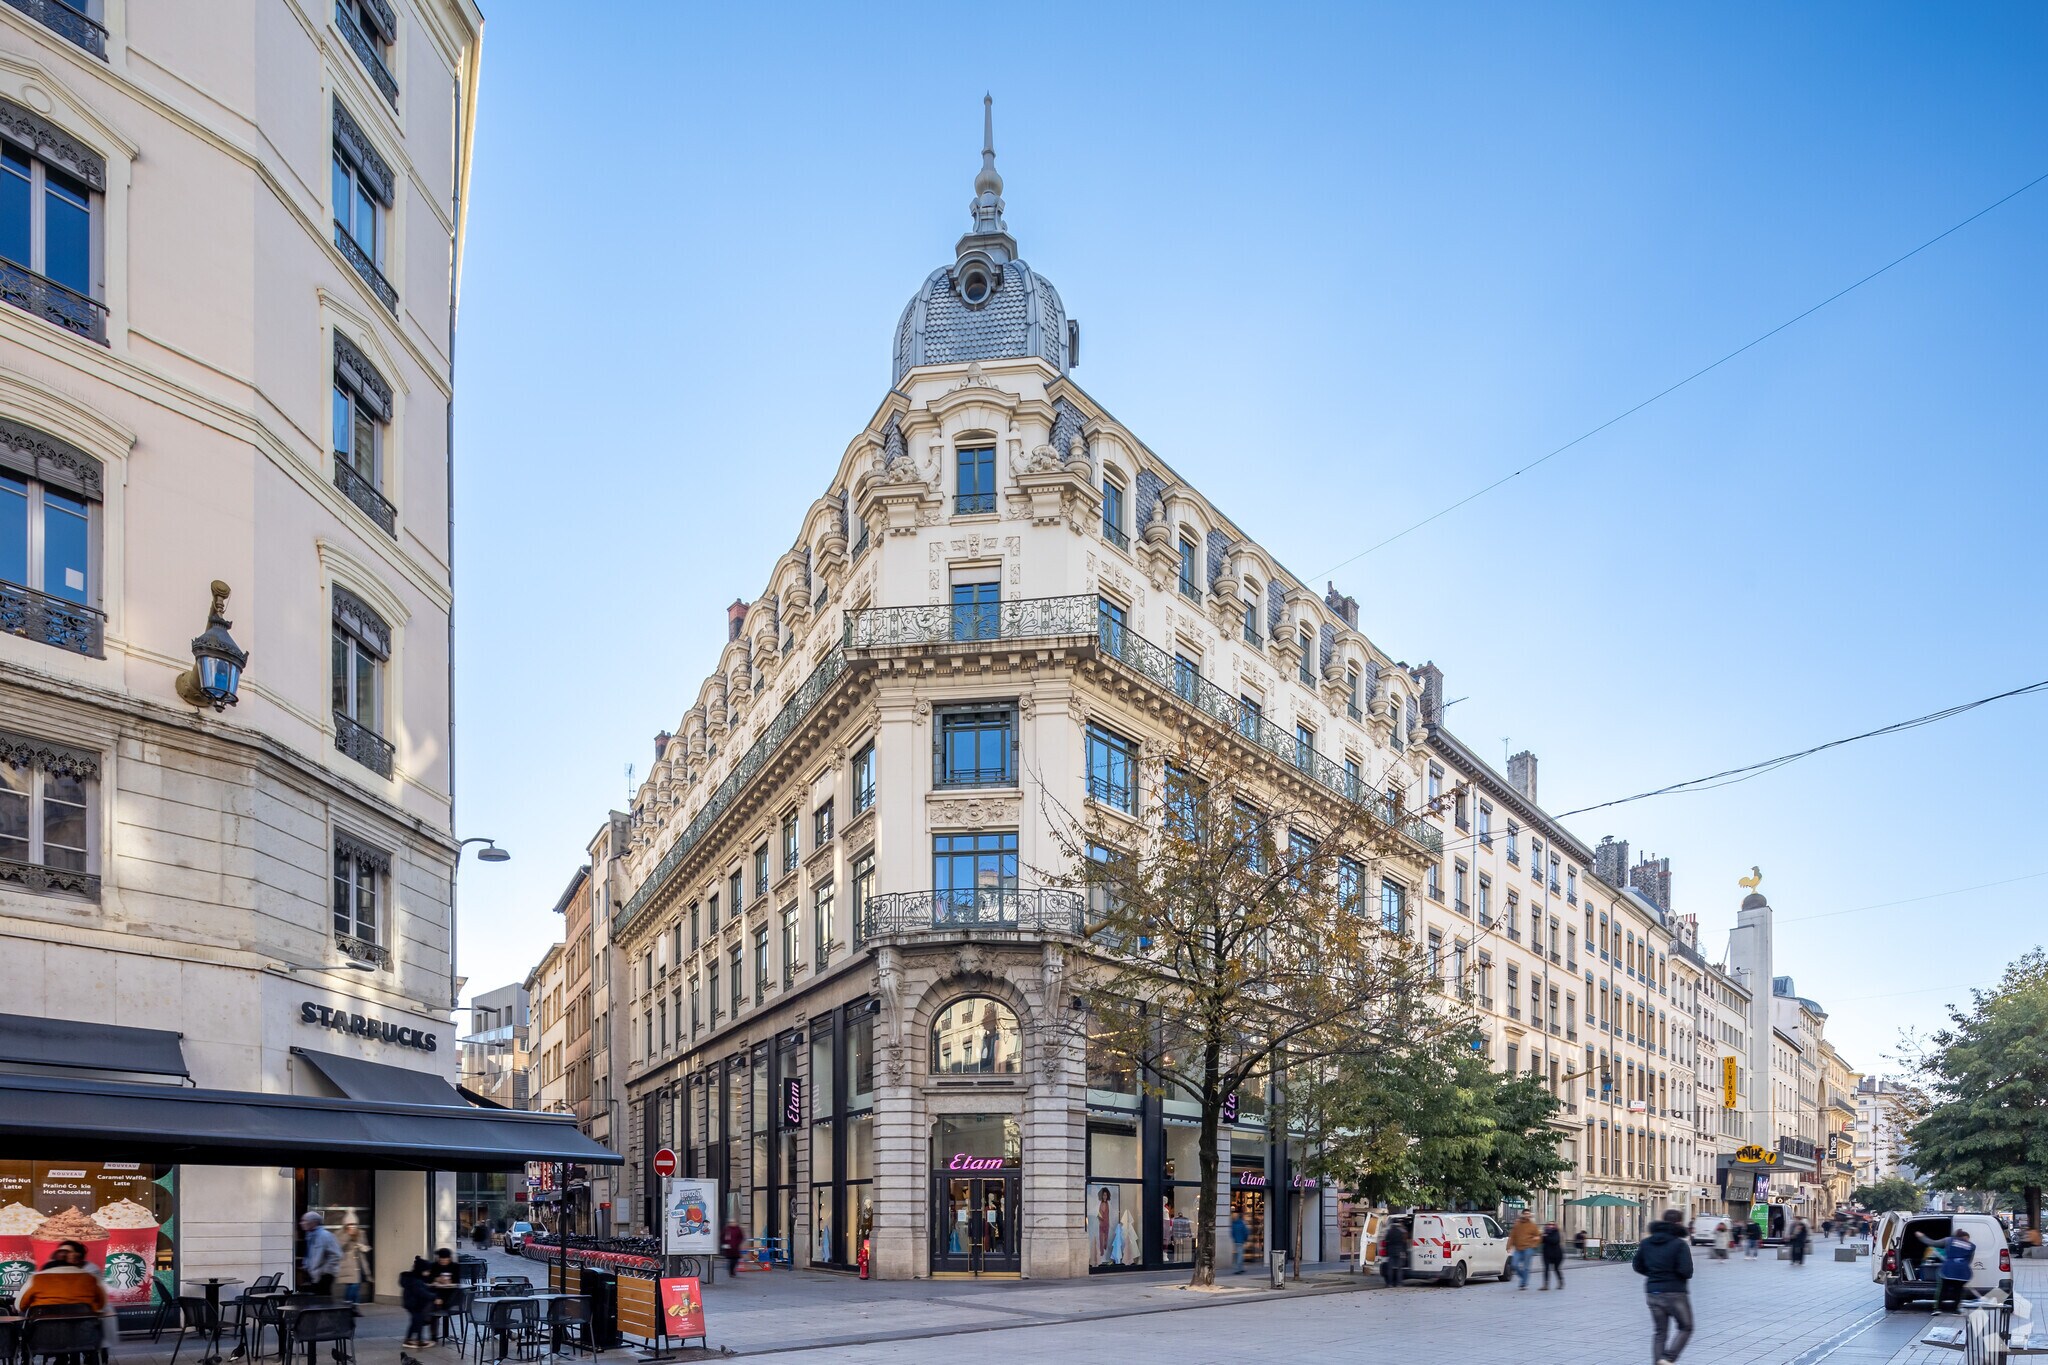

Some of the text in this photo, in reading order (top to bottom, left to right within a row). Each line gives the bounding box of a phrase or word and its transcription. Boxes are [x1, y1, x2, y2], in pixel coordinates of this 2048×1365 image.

[301, 1001, 437, 1052] STARBUCKS
[787, 1081, 800, 1123] Etam
[1224, 1092, 1236, 1119] Eta
[1828, 1136, 1837, 1155] fnac
[949, 1153, 1003, 1170] Etam
[1240, 1171, 1266, 1186] Etam
[1293, 1174, 1316, 1188] Eam
[1458, 1227, 1481, 1238] SPIE
